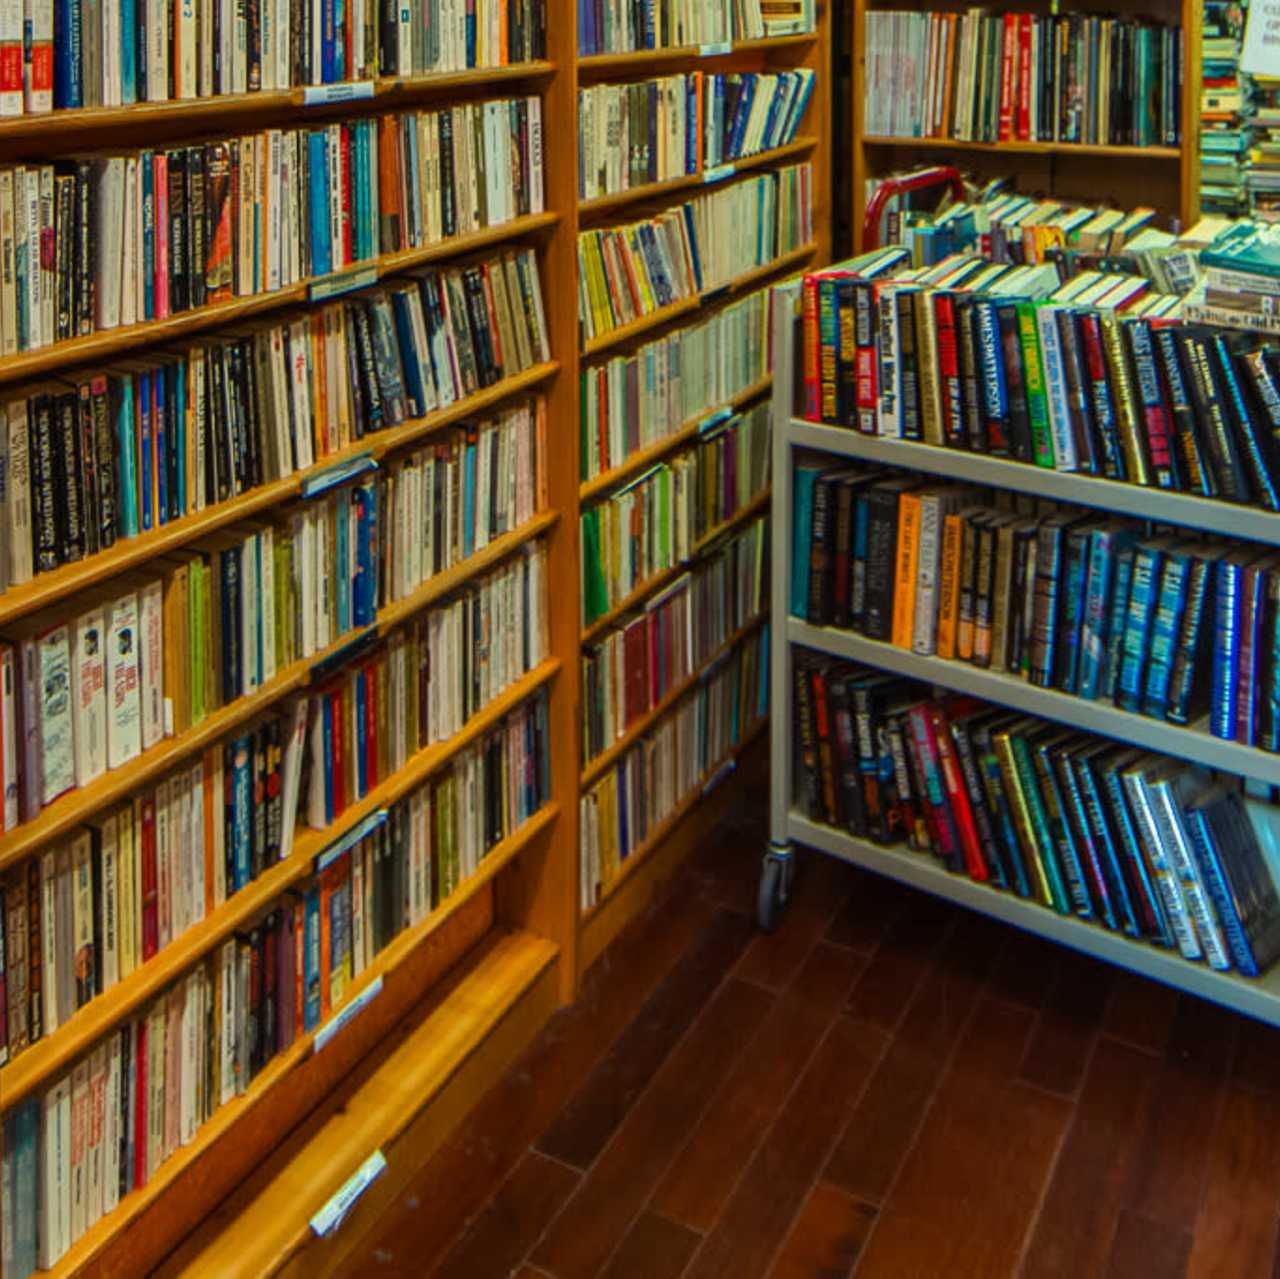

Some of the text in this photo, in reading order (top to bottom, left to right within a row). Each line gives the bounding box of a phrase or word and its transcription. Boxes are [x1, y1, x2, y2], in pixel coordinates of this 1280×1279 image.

[182, 10, 194, 18] 2
[978, 304, 1003, 417] JAMES PATTERSON
